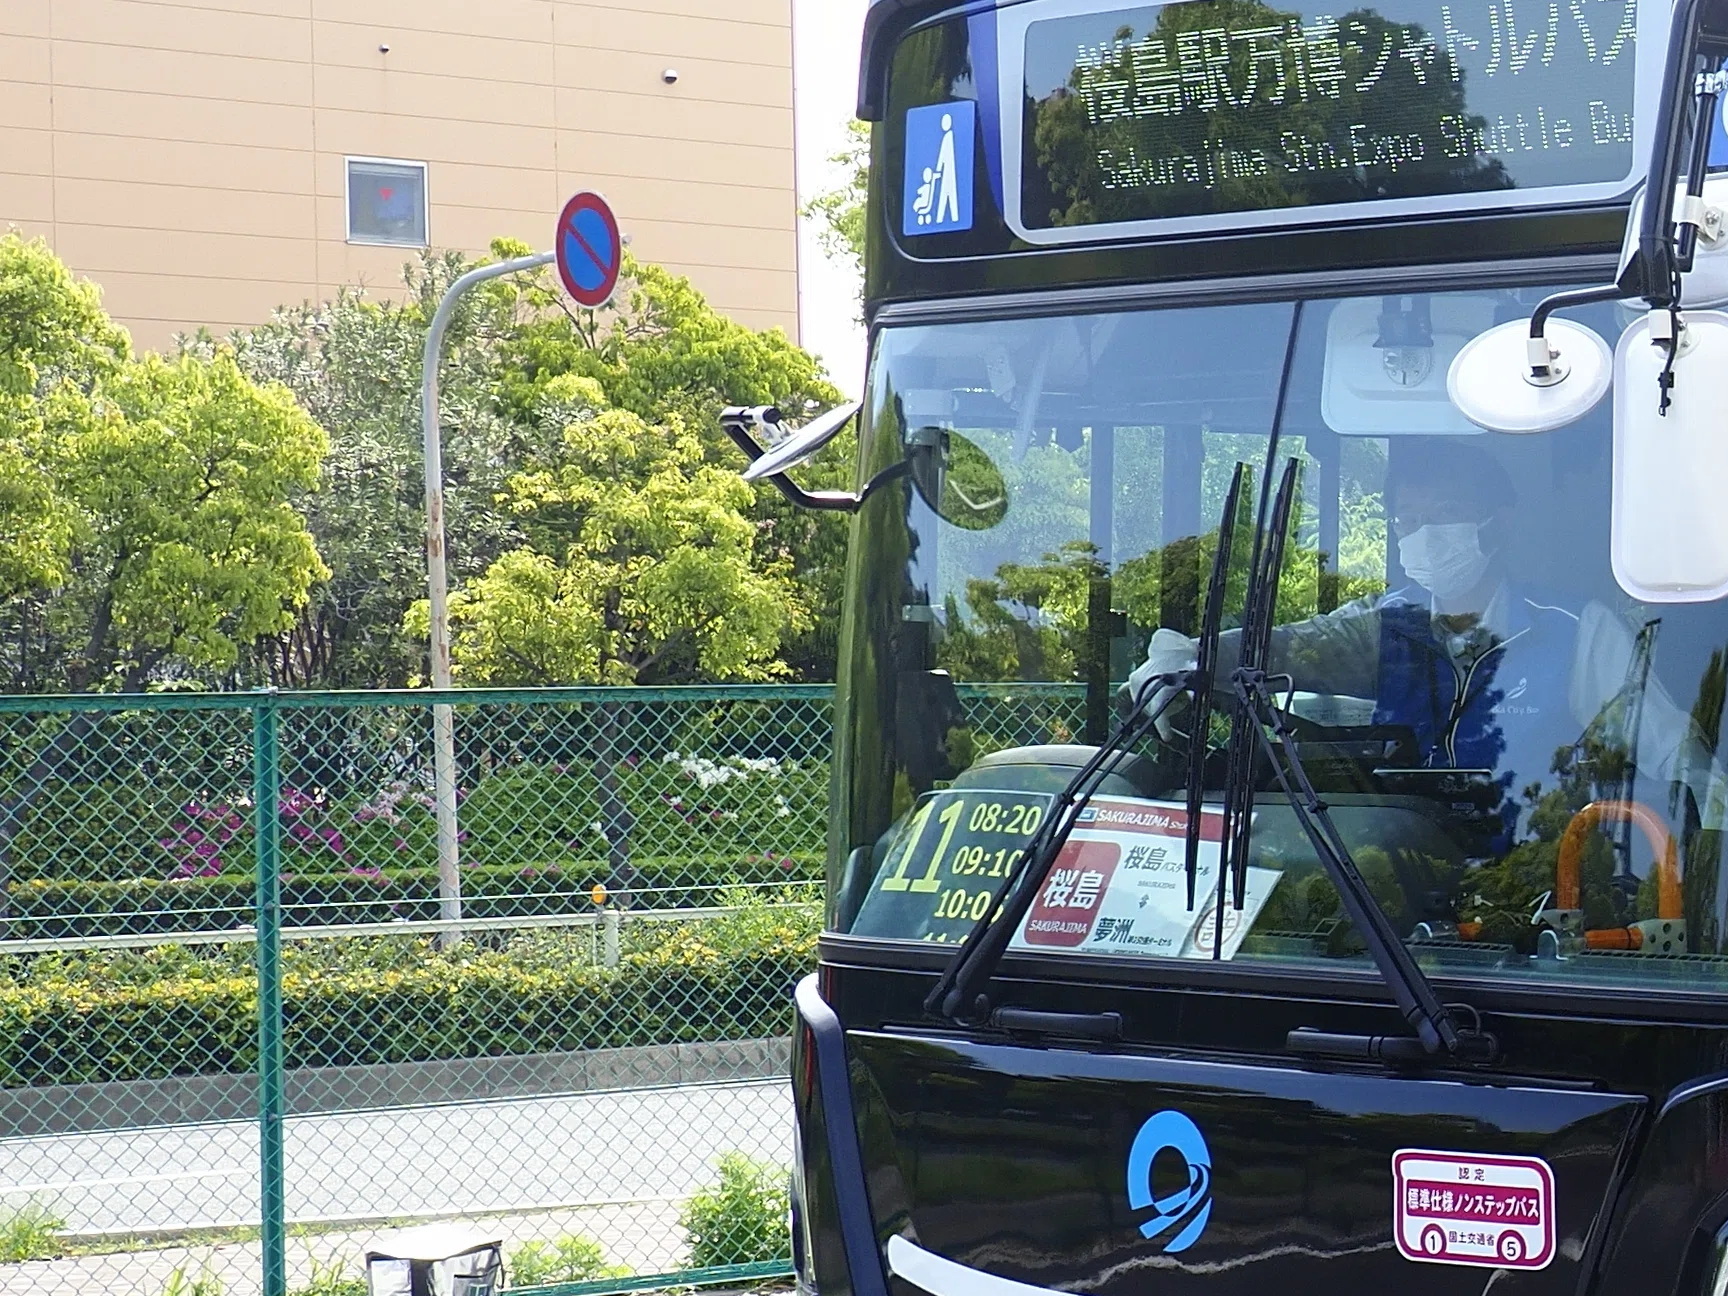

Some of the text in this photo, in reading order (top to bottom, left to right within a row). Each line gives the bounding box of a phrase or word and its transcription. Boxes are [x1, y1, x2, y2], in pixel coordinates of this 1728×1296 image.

[1098, 138, 1267, 190] Sakurajima
[1440, 105, 1573, 158] Shuttle
[1588, 100, 1635, 145] Bu
[1096, 809, 1171, 830] SAKURAJIMA
[880, 799, 1043, 894] 11 08:20
[1042, 867, 1104, 911] 桜島
[1028, 918, 1089, 935] SAKURAJIMA
[1458, 1166, 1486, 1182] 認定
[1407, 1187, 1540, 1218] 標準仕様ノンステップバス
[1429, 1233, 1437, 1252] 1
[1506, 1241, 1517, 1257] 5
